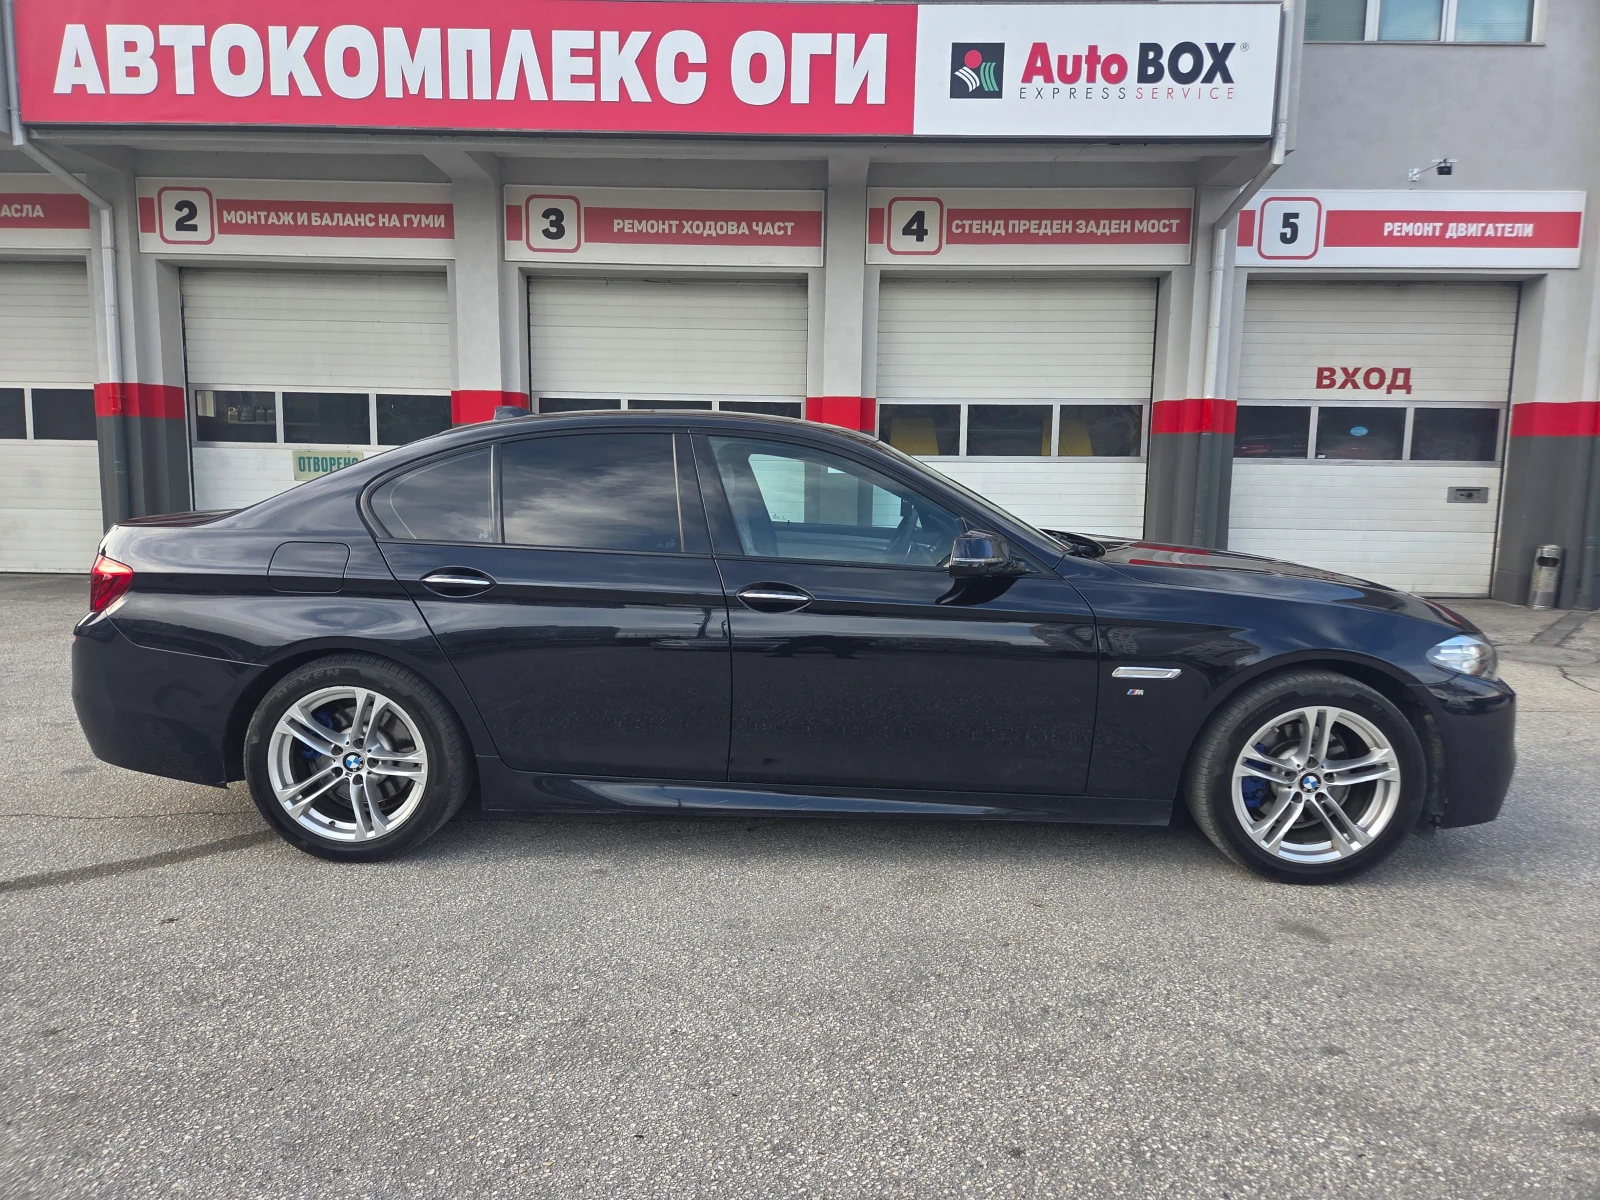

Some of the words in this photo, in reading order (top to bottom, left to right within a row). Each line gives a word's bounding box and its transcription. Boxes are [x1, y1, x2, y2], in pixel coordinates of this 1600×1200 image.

[53, 23, 707, 105] АВТОКОМПЛЕКС
[730, 30, 888, 106] ОГИ
[1020, 42, 1128, 85] Auto
[1137, 41, 1236, 85] BOX
[1019, 87, 1126, 100] EXPRESS
[1136, 87, 1234, 100] SERVICE
[174, 200, 198, 232] 2
[222, 210, 294, 226] МОНТАЖ
[297, 212, 308, 226] И
[311, 212, 376, 228] БАЛАНС
[378, 214, 400, 228] НА
[403, 214, 445, 228] ГУМИ
[541, 207, 566, 240] 3
[613, 219, 680, 235] РЕМОНТ
[681, 220, 749, 237] ХОДОВА
[752, 221, 795, 236] ЧАСТ
[902, 210, 928, 242] 4
[951, 219, 1005, 236] СТЕНД
[1008, 219, 1073, 236] ПРЕДЕН
[1075, 219, 1132, 236] ЗАДЕН
[1134, 219, 1180, 234] МОСТ
[1279, 212, 1300, 245] 5
[1383, 222, 1443, 237] РЕМОНТ
[1445, 223, 1534, 239] ДВИГАТЕЛИ
[1315, 367, 1412, 395] ВХОД
